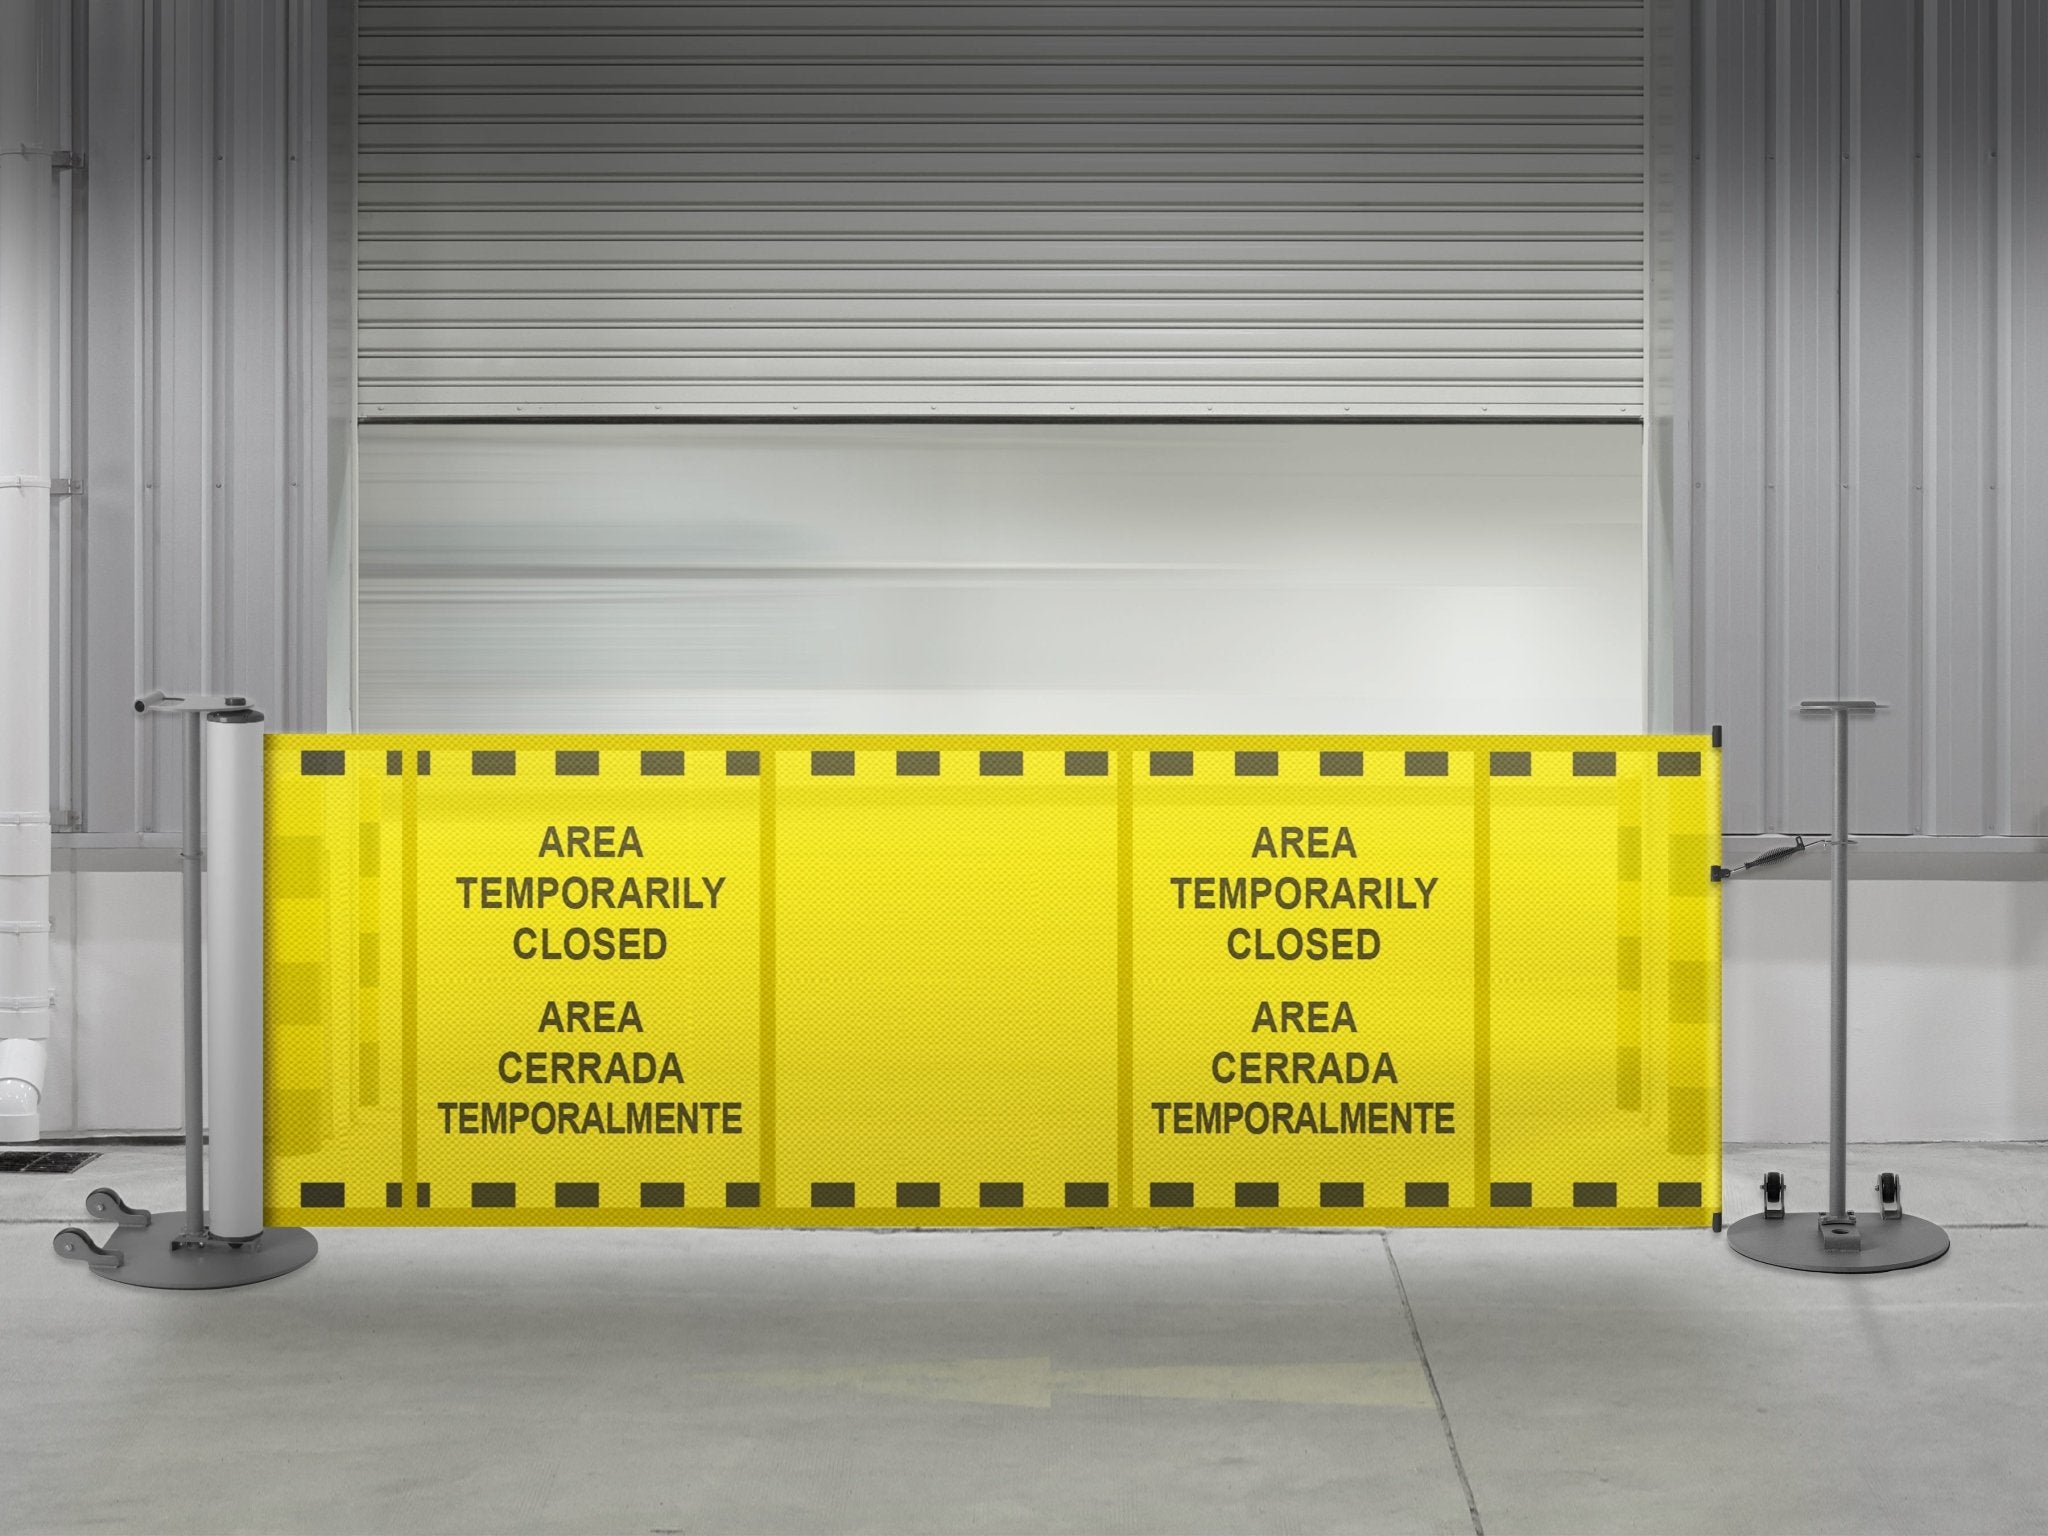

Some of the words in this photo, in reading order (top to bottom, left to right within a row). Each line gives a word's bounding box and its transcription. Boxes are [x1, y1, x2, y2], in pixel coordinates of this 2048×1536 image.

[538, 826, 643, 858] AREA
[1252, 826, 1357, 858] AREA
[456, 876, 726, 909] TEMPORARILY
[1170, 876, 1439, 909] TEMPORARILY
[513, 927, 667, 960] CLOSED
[1227, 927, 1381, 960] CLOSED
[538, 1001, 644, 1033] AREA
[1252, 1001, 1357, 1033] AREA
[498, 1051, 685, 1084] CERRADA
[1212, 1051, 1398, 1084] CERRADA
[438, 1101, 743, 1134] TEMPORALMENTE
[1151, 1101, 1455, 1134] TEMPORALMENTE
